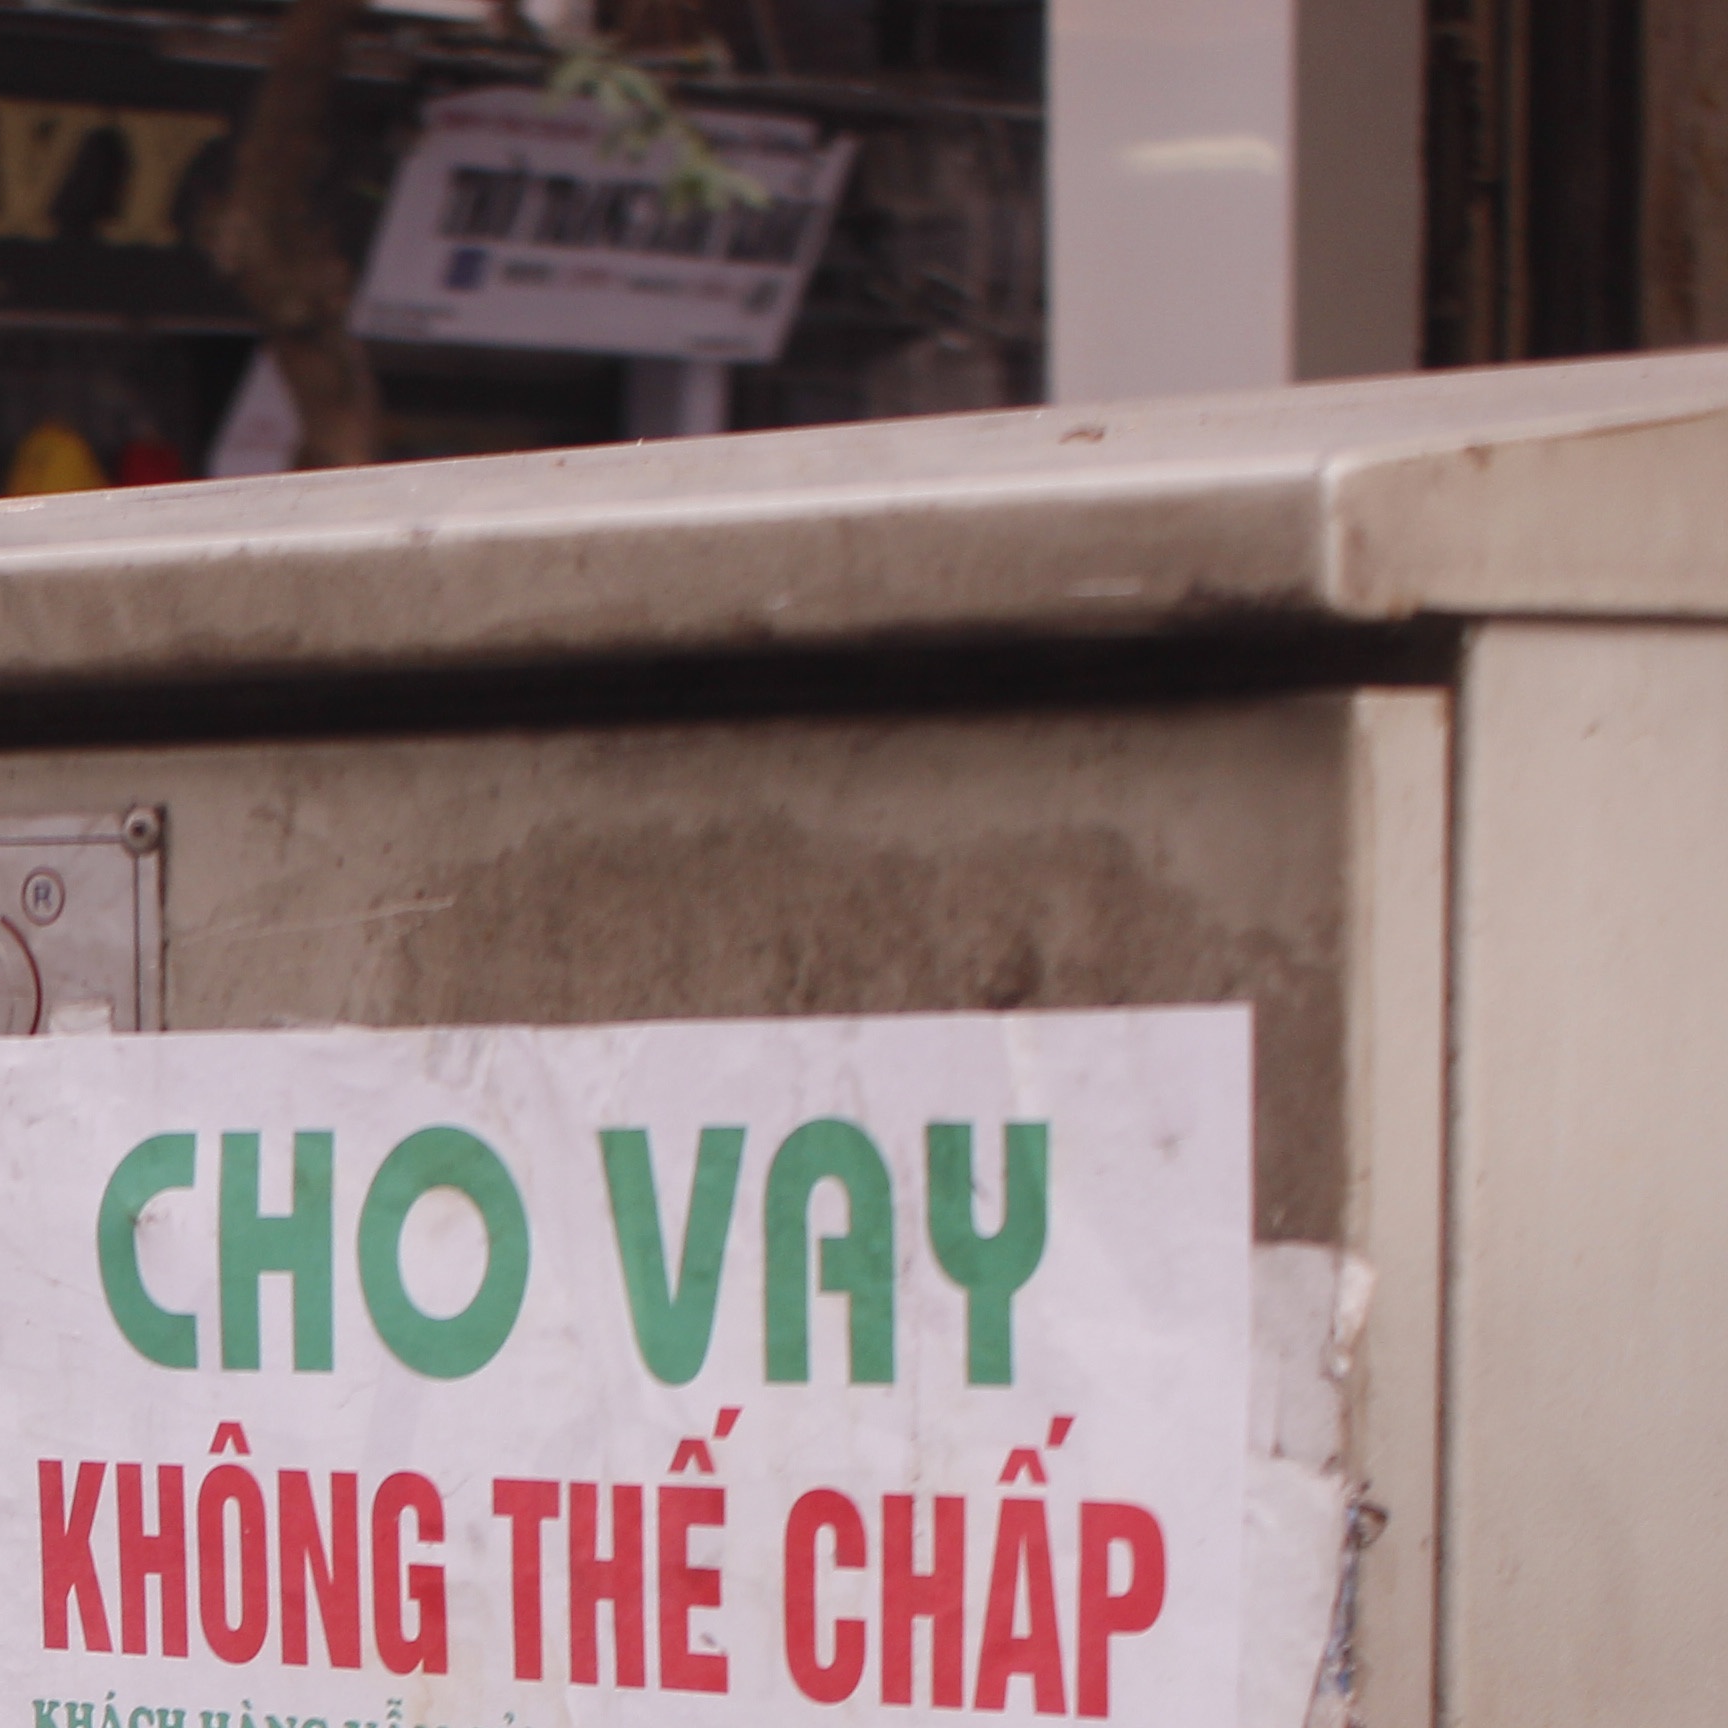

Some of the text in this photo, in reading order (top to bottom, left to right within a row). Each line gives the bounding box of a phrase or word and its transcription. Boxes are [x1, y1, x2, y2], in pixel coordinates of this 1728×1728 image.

[97, 1117, 1050, 1387] CHO VAY
[37, 1407, 1167, 1720] KHÔNG THẾ CHẤP
